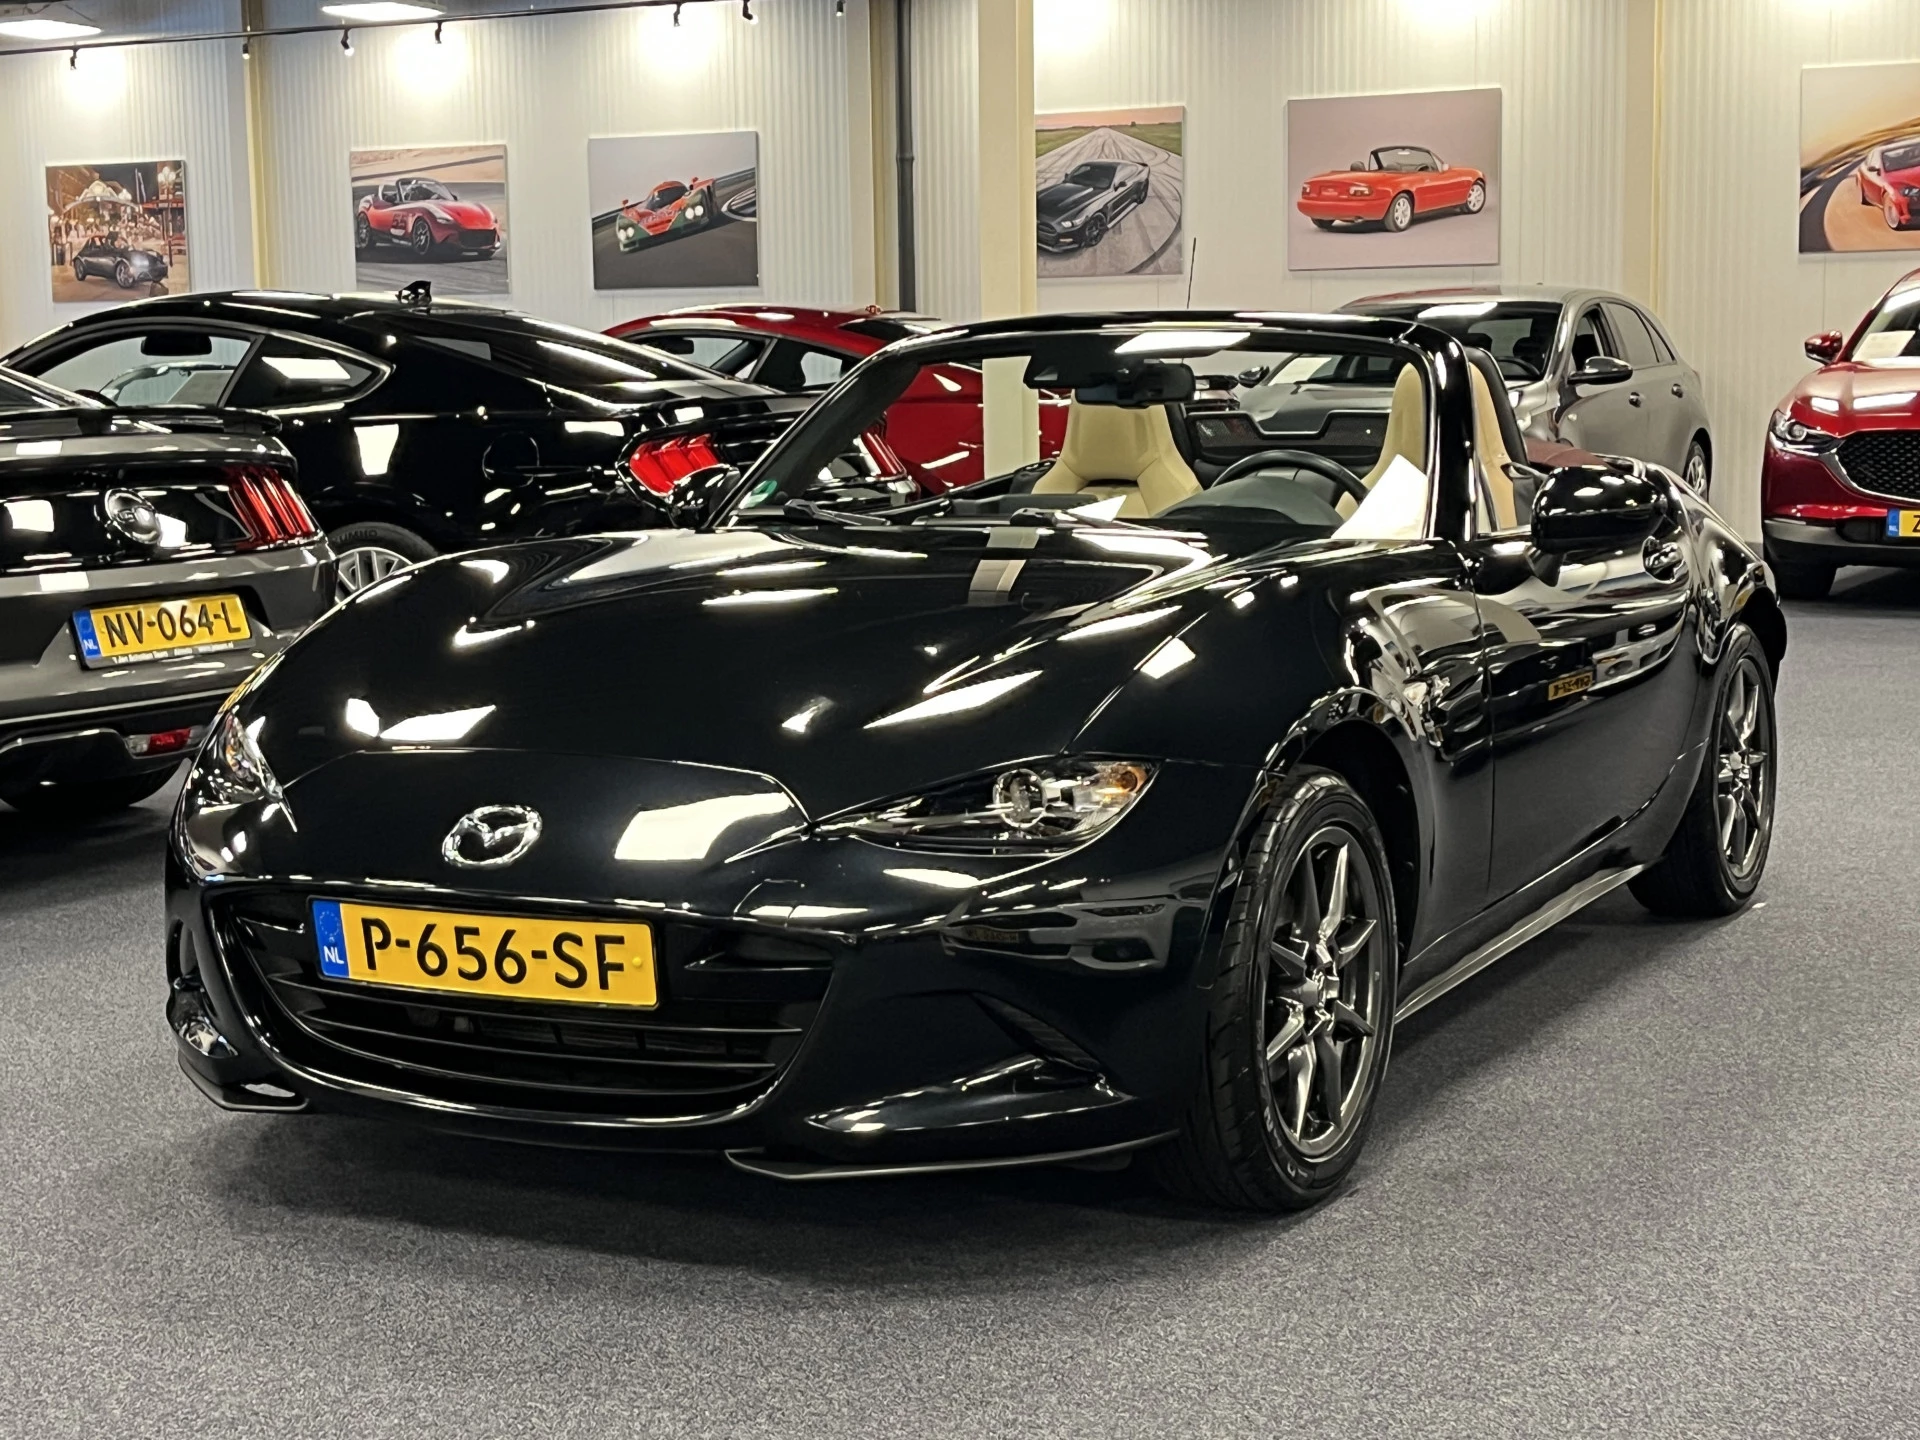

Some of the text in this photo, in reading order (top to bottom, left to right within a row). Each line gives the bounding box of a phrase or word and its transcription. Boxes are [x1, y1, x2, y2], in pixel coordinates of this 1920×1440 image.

[103, 602, 242, 648] NV-064-L
[83, 639, 99, 650] NL
[323, 945, 345, 965] NL
[361, 917, 625, 991] P-656-SF
